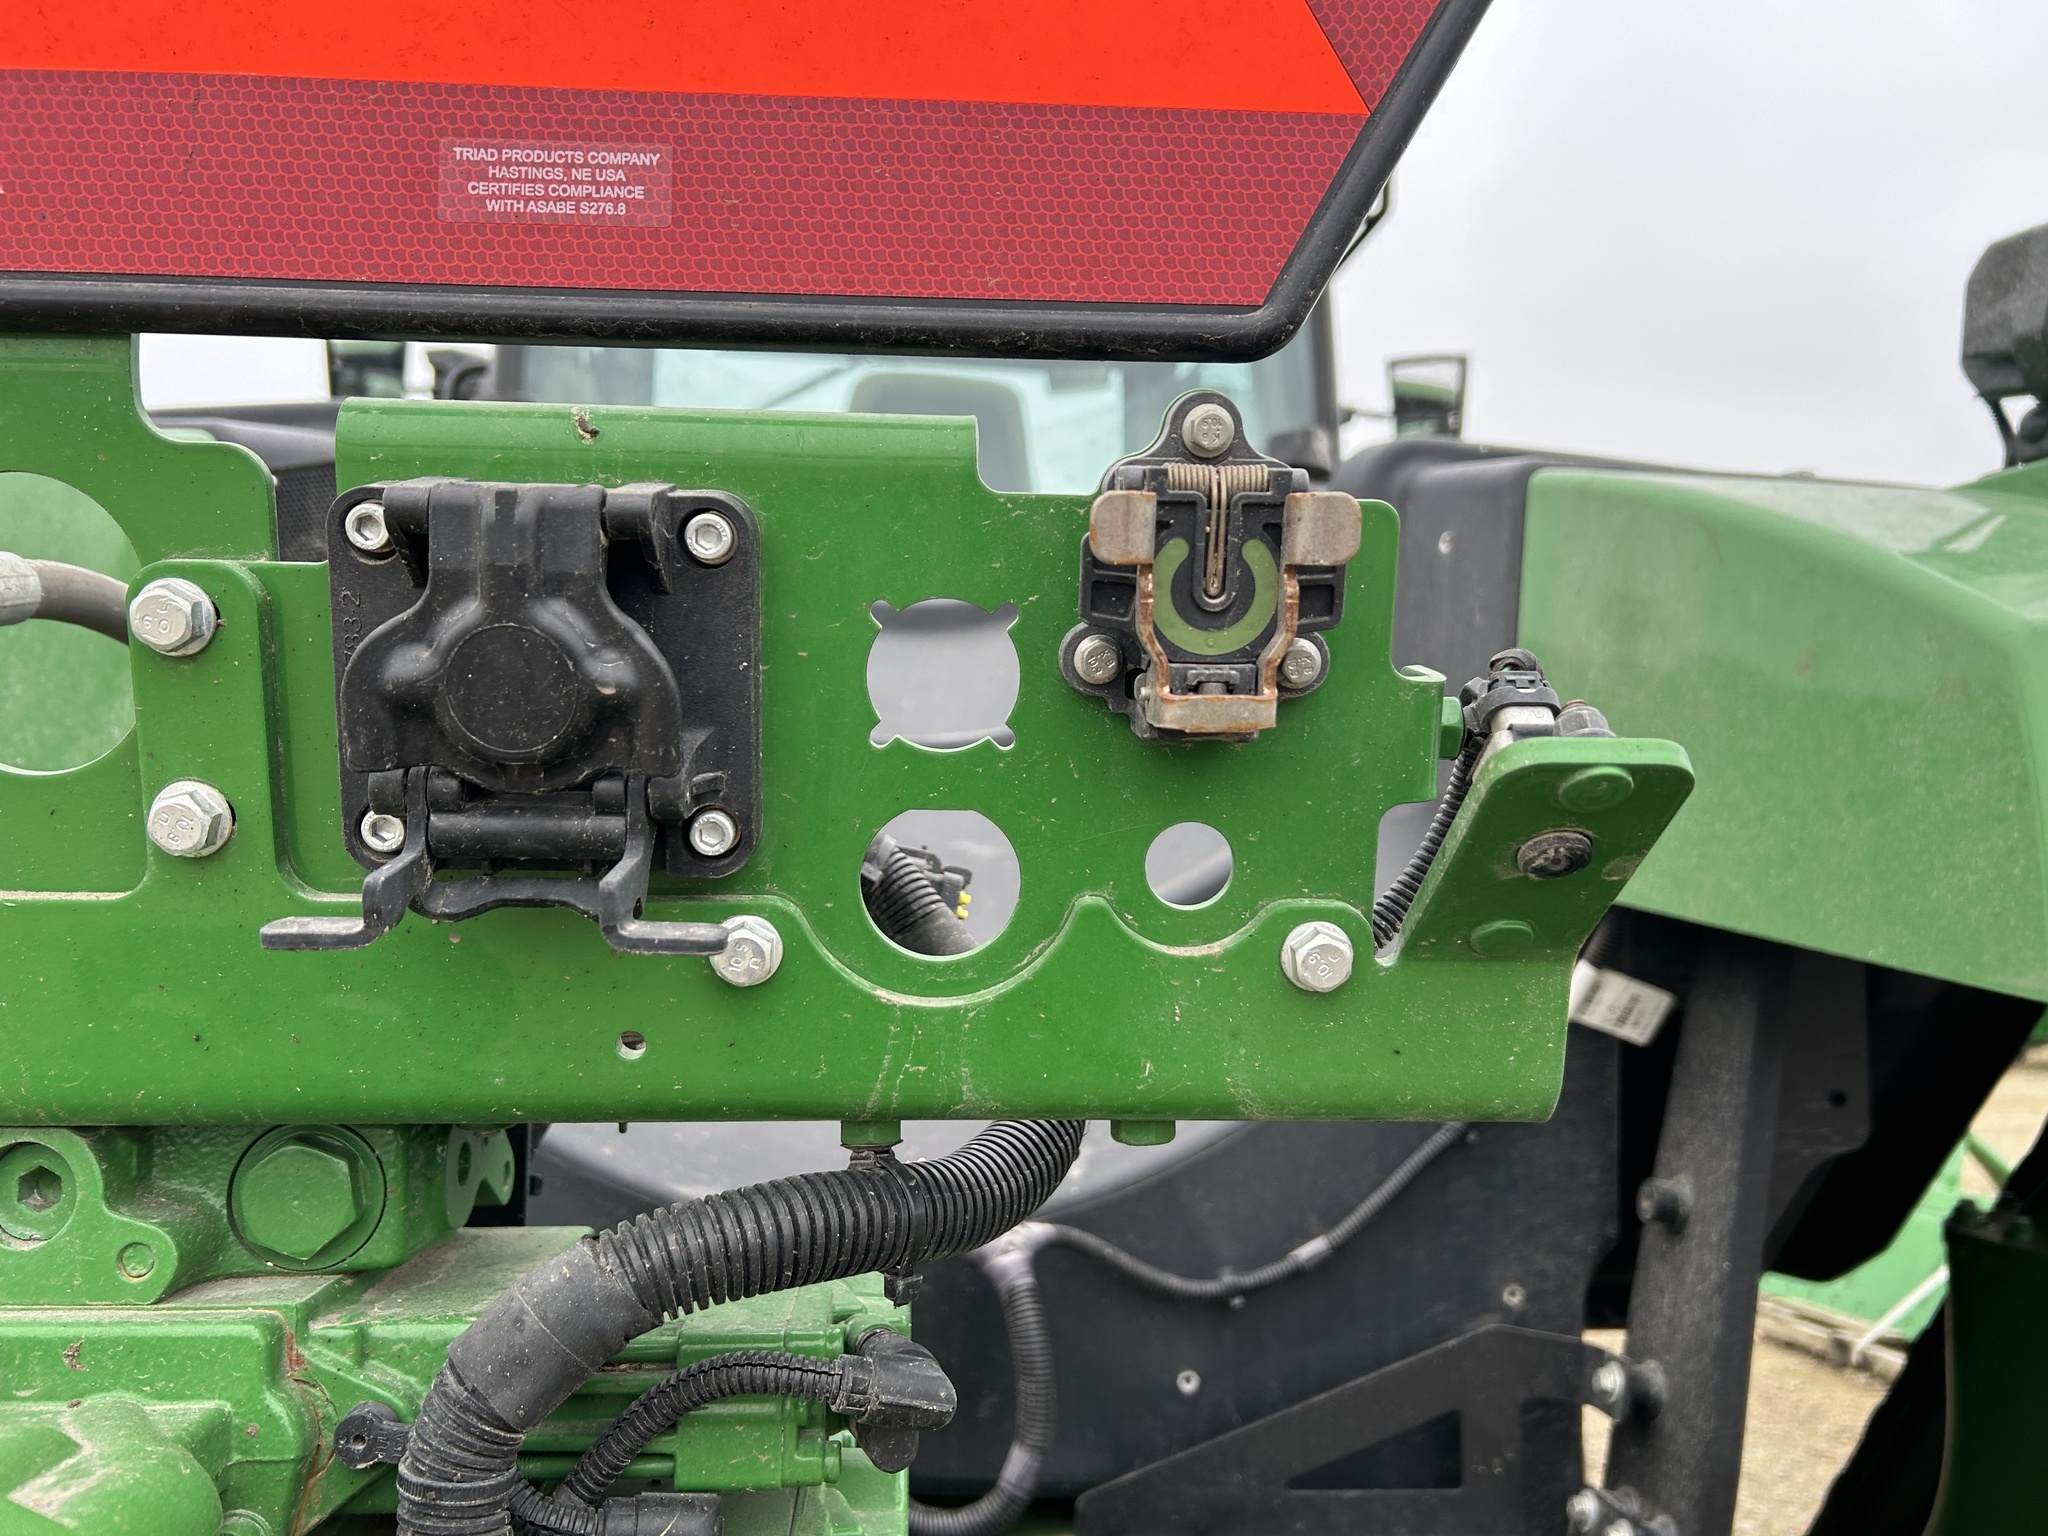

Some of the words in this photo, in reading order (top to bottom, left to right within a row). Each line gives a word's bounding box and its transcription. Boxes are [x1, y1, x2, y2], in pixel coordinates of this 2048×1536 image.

[453, 147, 498, 162] TRIAD
[502, 149, 584, 164] PRODUCTS
[588, 151, 661, 166] COMPANY
[488, 165, 568, 182] HASTINGS,
[571, 168, 592, 181] NE
[595, 168, 627, 182] USA
[467, 181, 545, 197] CERTIFIES
[548, 183, 645, 199] COMPLIANCE
[485, 199, 524, 213] WITH
[526, 200, 576, 214] ASABE
[579, 202, 627, 216] S276.8
[1308, 952, 1334, 980] 10.9
